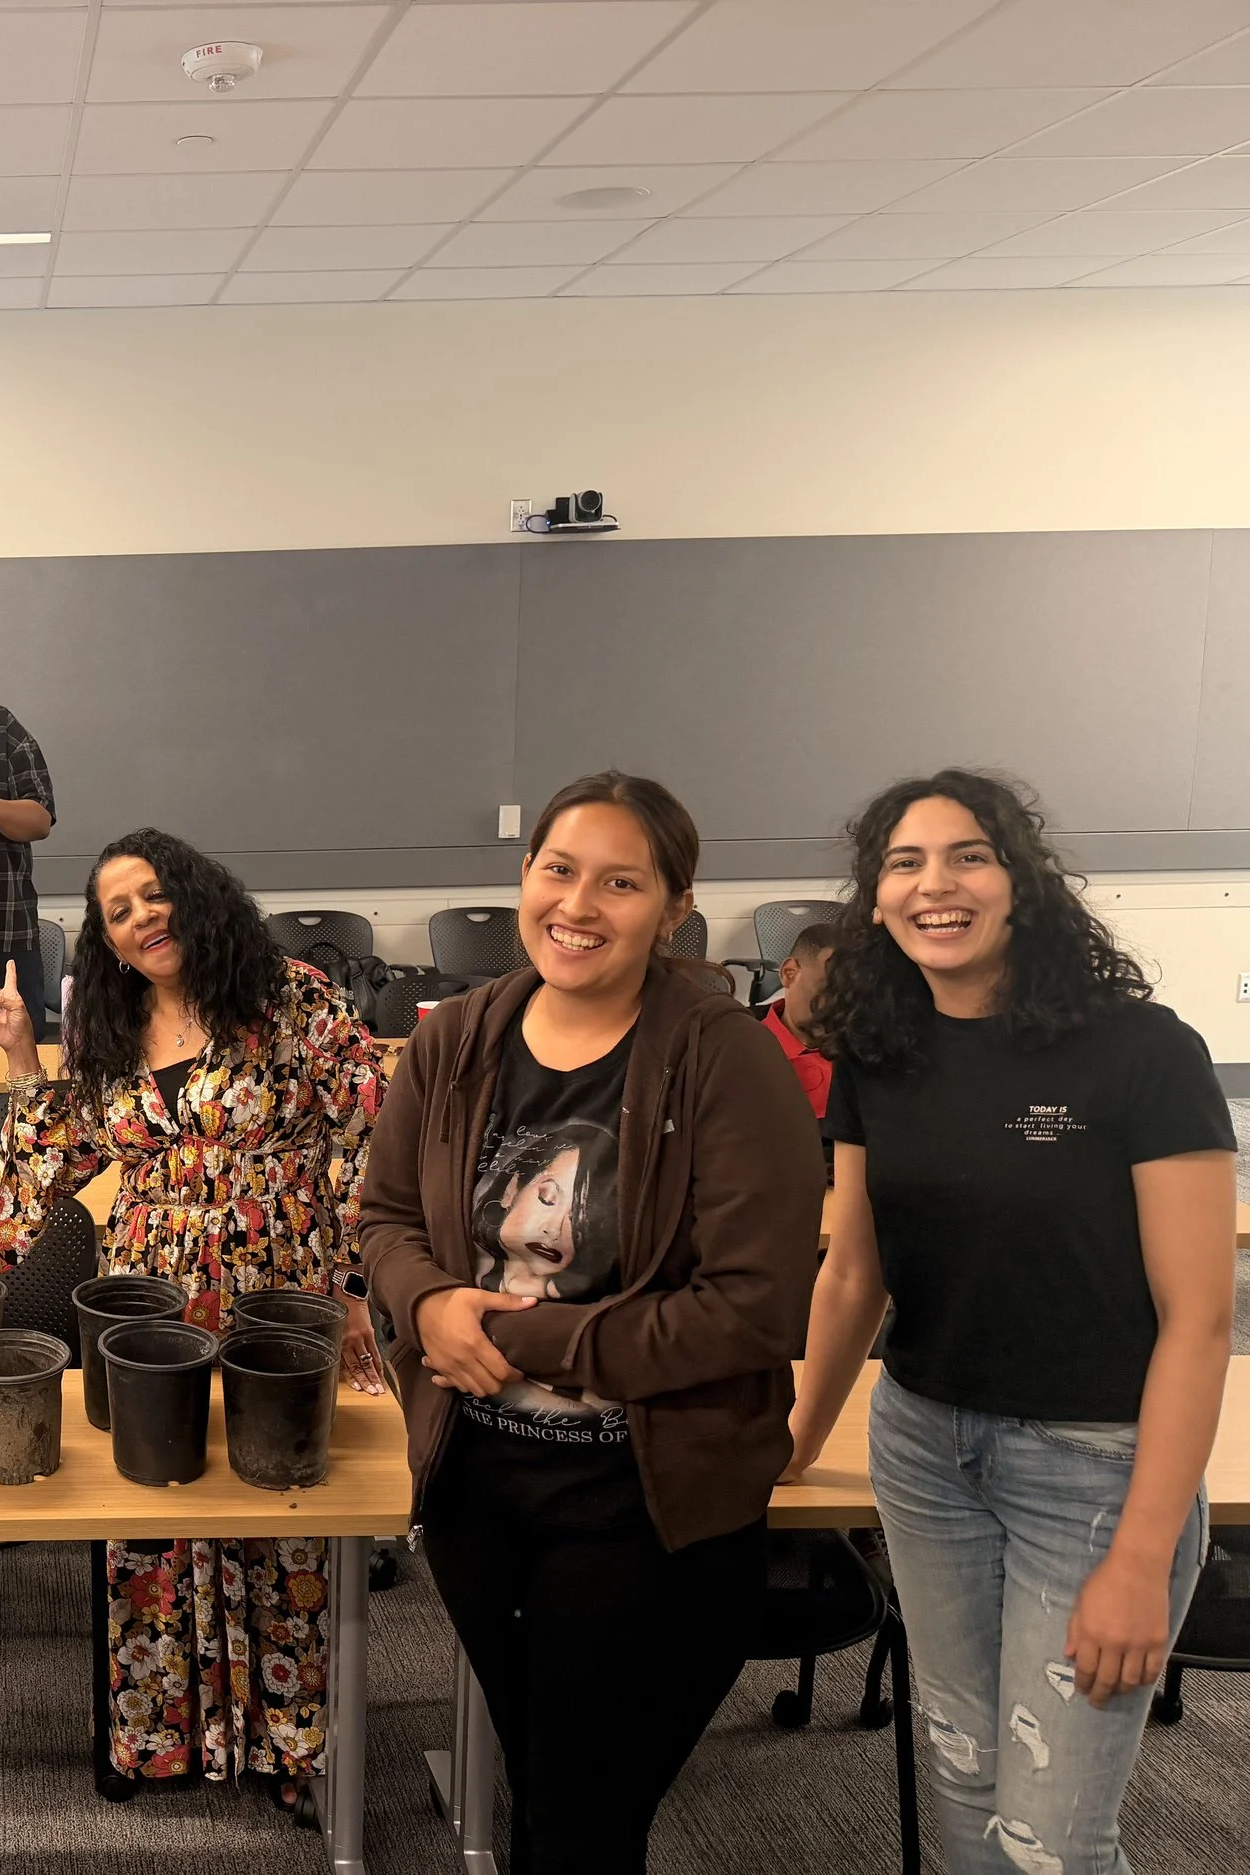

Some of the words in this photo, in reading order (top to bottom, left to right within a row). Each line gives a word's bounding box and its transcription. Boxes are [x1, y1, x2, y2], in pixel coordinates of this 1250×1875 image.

[196, 45, 222, 58] FIRE
[530, 1406, 581, 1426] the
[498, 1416, 593, 1443] PRINCESS
[599, 1431, 628, 1443] OF
